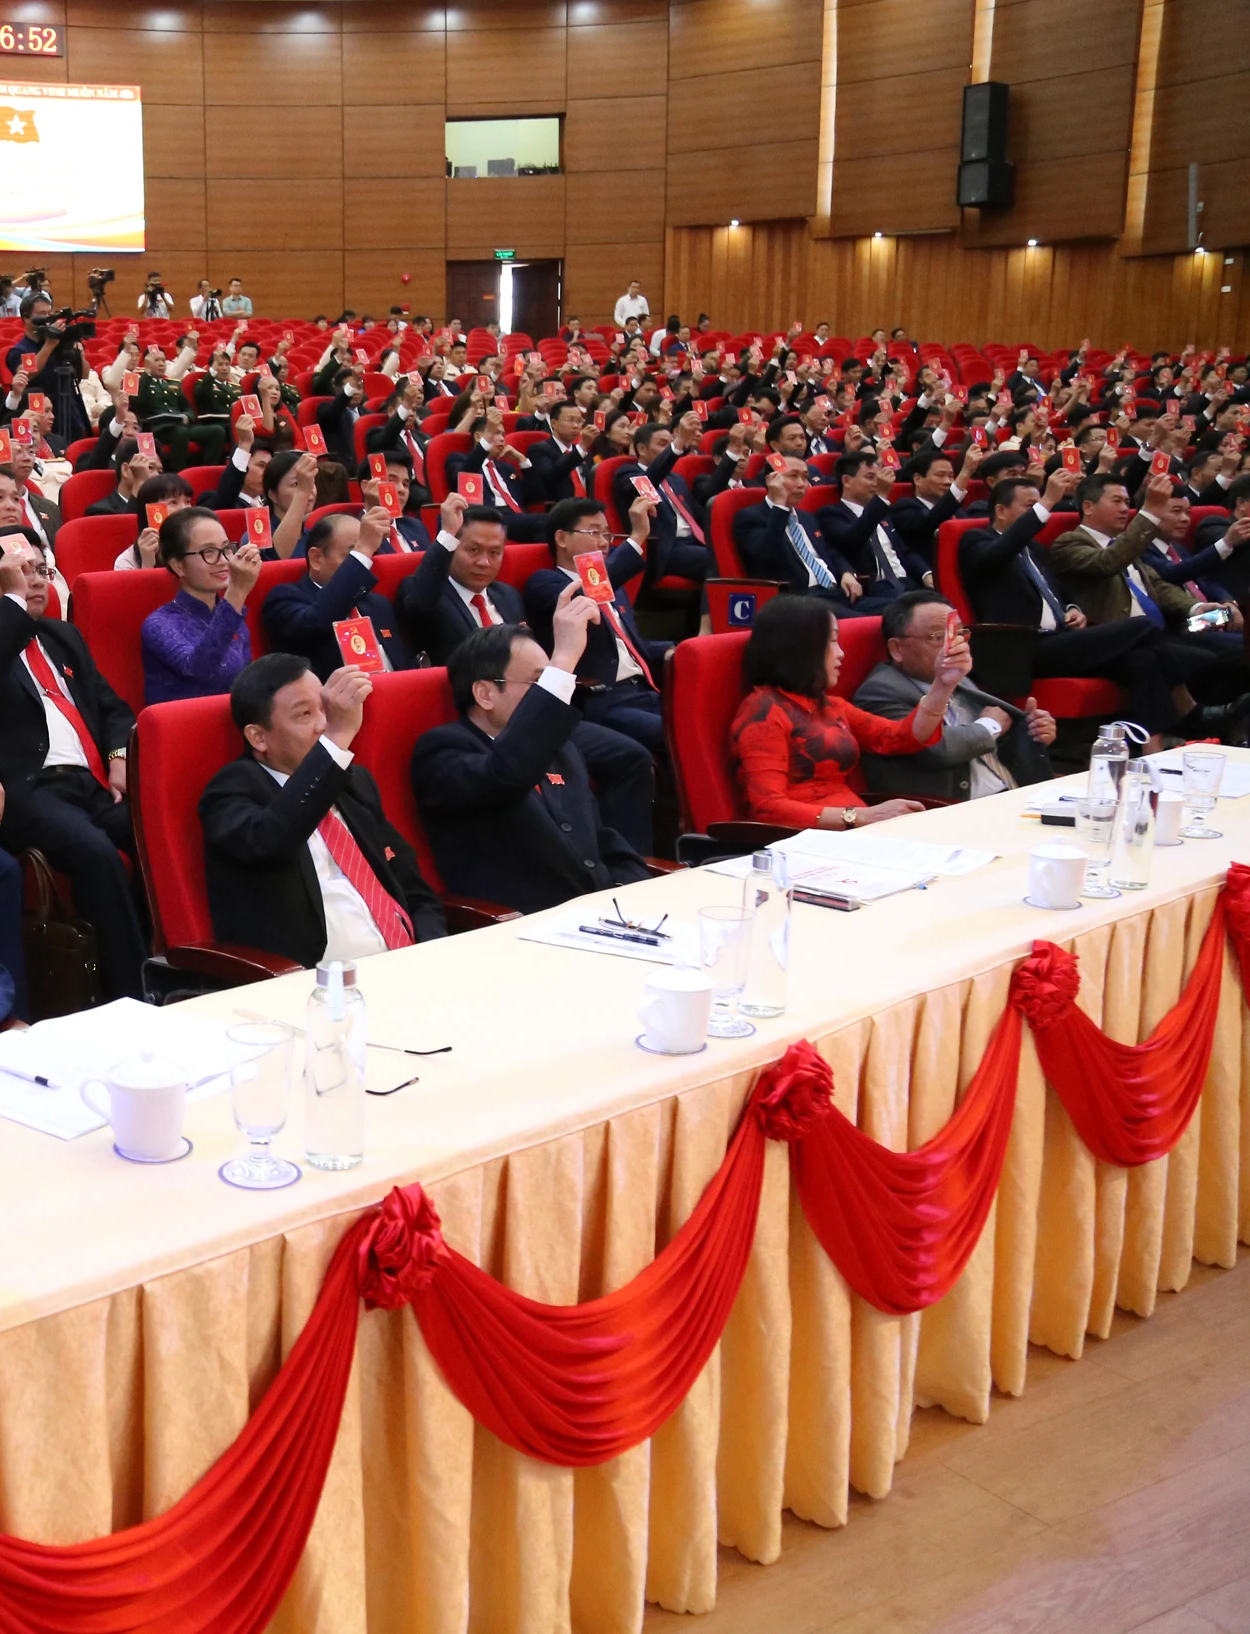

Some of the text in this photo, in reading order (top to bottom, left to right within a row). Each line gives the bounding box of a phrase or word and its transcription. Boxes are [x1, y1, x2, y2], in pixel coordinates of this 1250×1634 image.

[8, 85, 41, 96] QUANG
[42, 87, 66, 97] VINH
[733, 600, 750, 620] C
